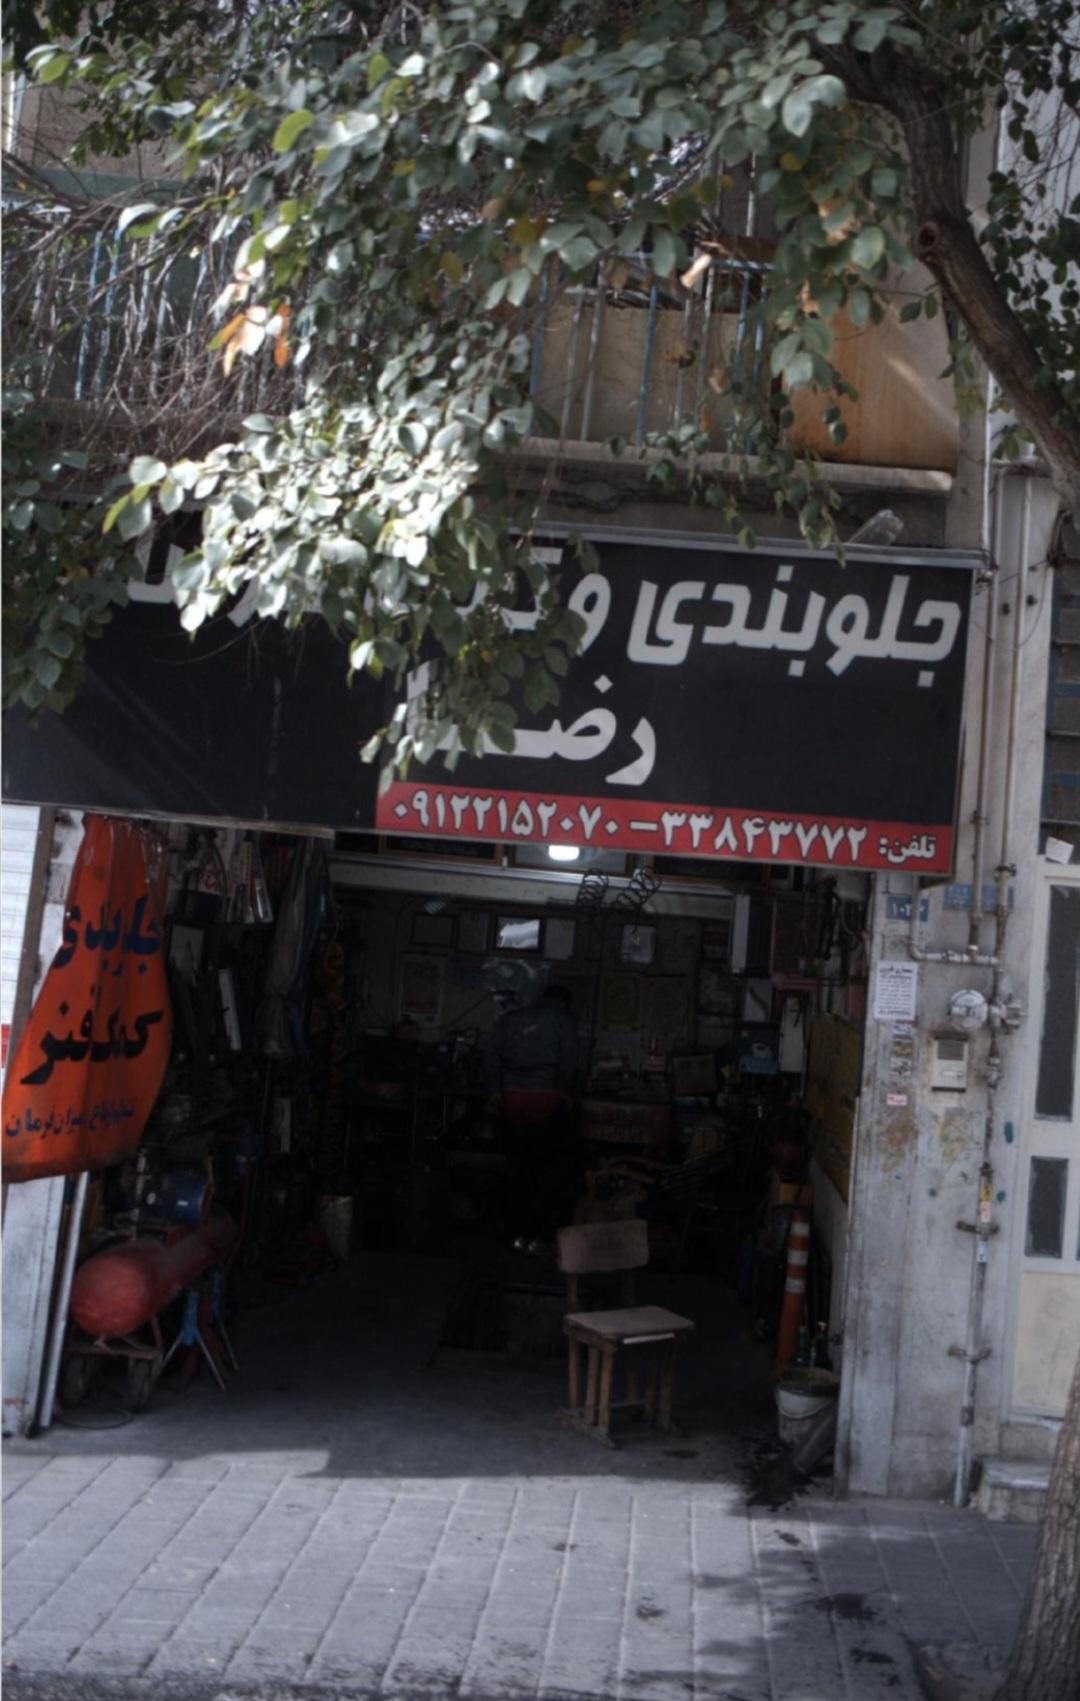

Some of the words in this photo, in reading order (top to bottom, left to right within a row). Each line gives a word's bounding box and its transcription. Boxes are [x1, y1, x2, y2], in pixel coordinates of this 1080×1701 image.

[626, 564, 962, 688] جلوبندی
[393, 789, 620, 840] ۰۹۱۲۲۱۵۲۰۷۰
[660, 810, 868, 861] ۳۳۸۴۳۷۷۲
[878, 834, 937, 864] تلفن:
